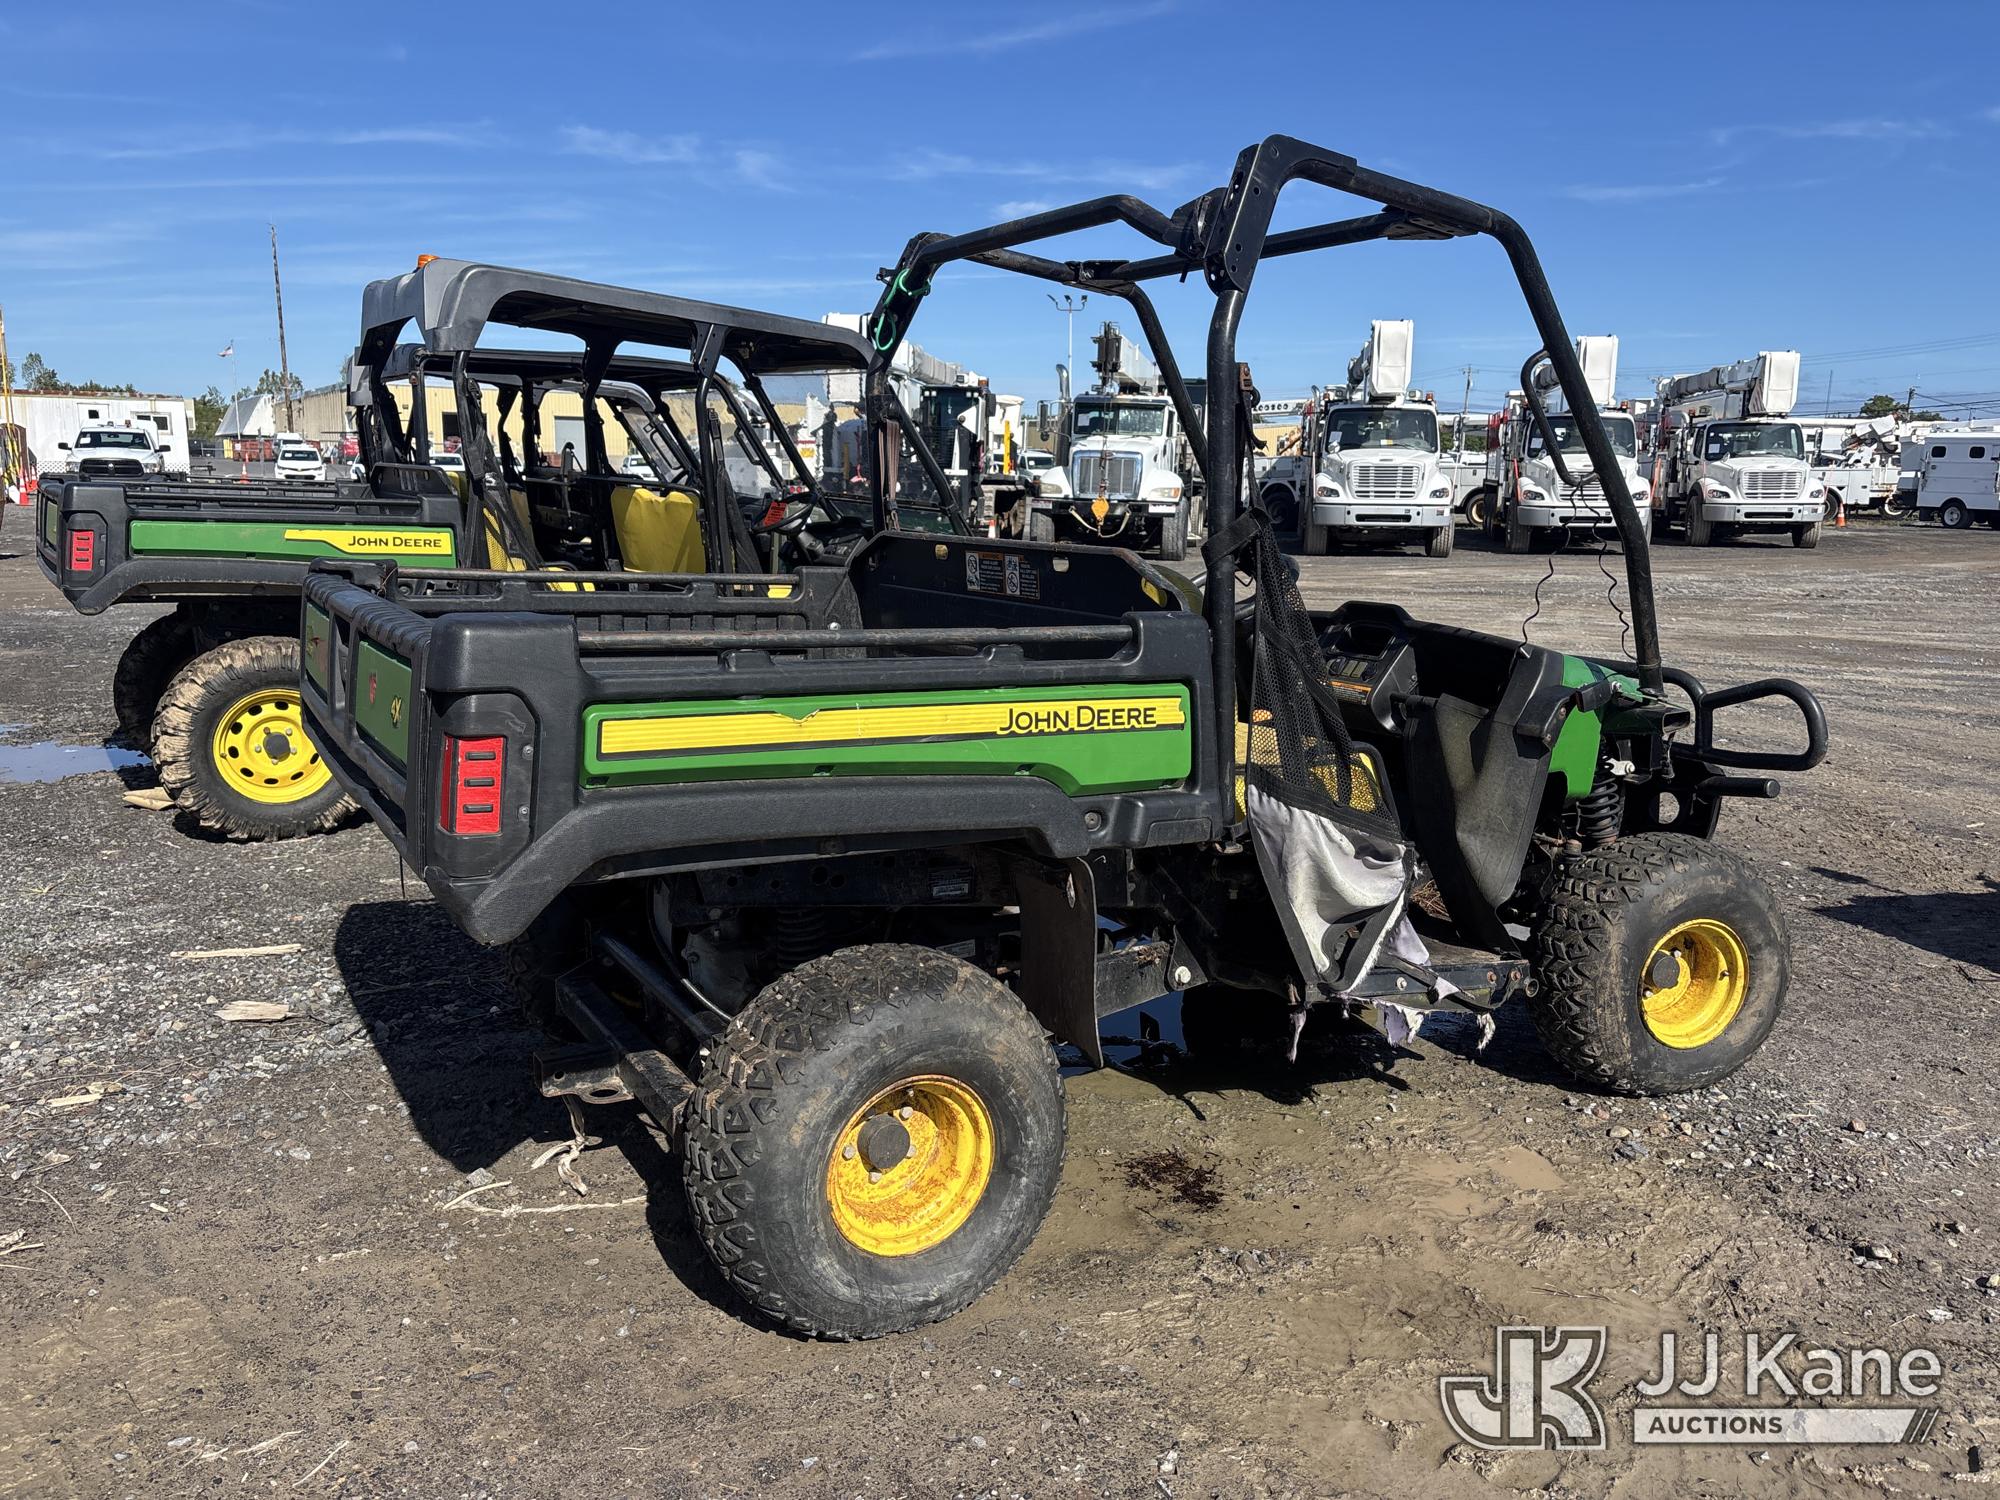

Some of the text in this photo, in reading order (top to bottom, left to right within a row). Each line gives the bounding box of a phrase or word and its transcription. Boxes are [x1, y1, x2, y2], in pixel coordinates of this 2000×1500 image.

[348, 535, 442, 548] JOHN DEERE
[999, 705, 1157, 732] JOHN DEERE
